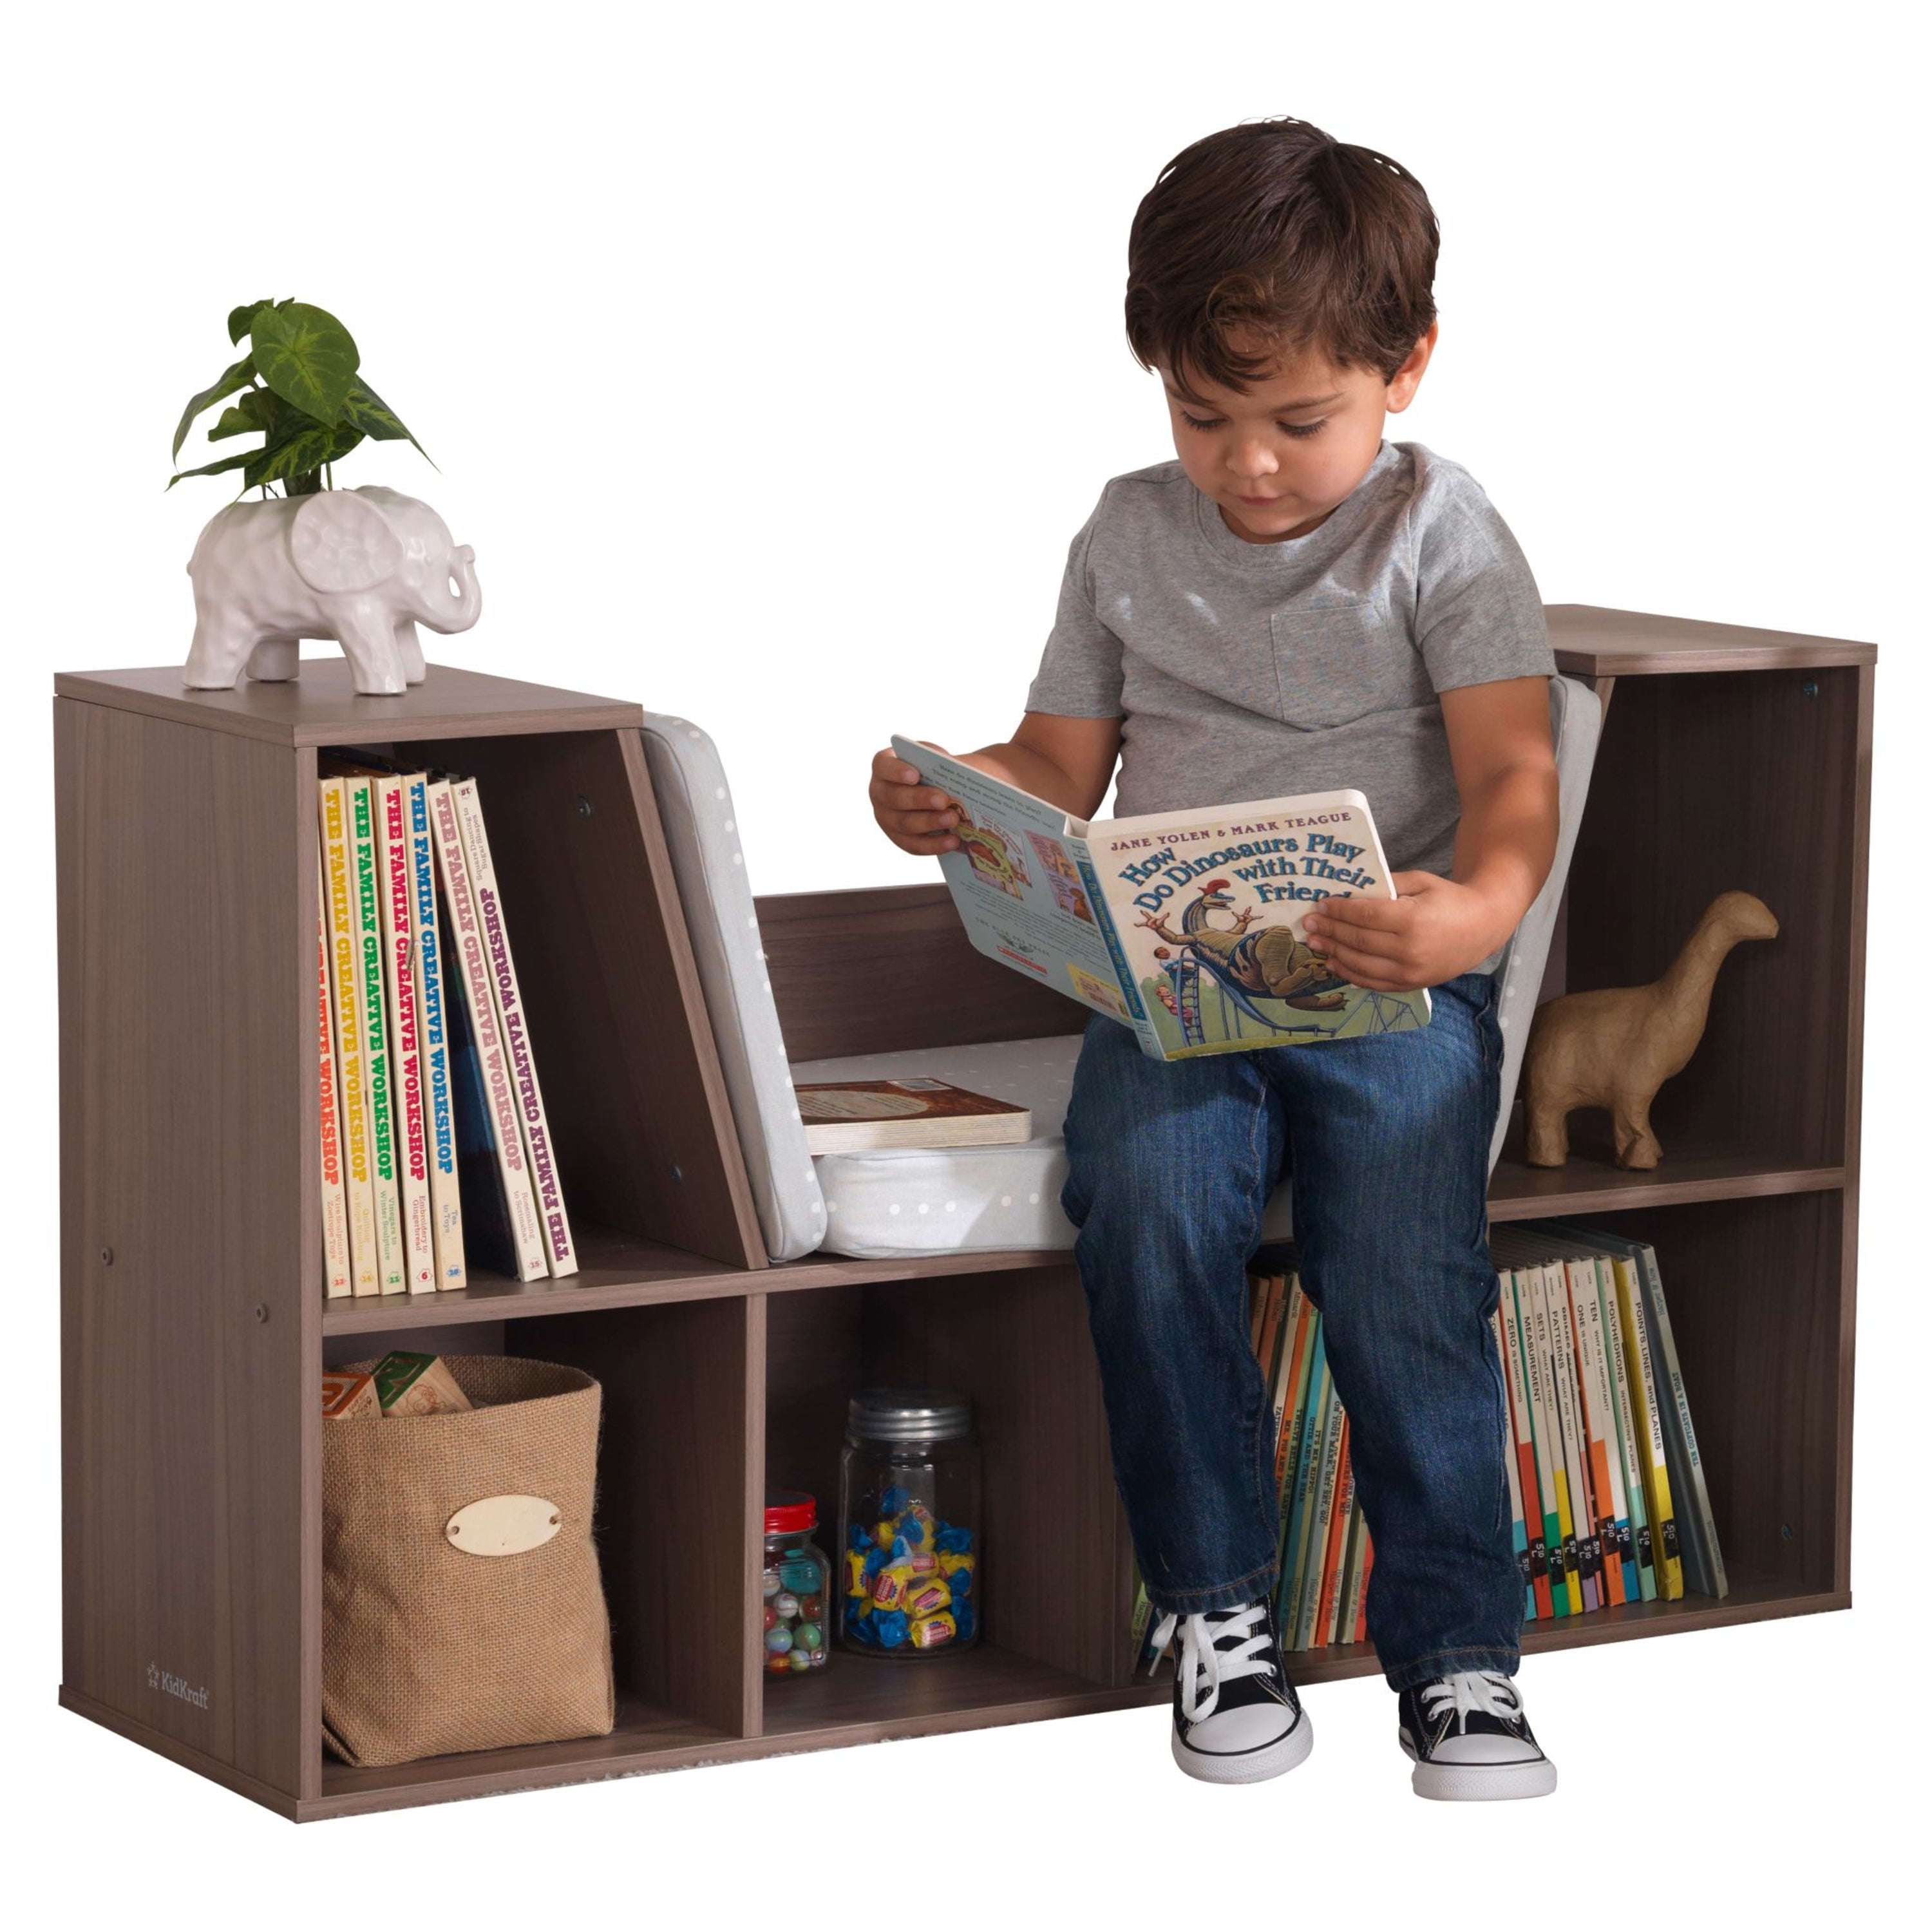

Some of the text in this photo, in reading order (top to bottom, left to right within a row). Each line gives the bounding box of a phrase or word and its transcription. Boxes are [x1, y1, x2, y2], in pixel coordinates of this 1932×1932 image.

[465, 816, 477, 851] Dancing
[472, 814, 488, 870] Sugar Shapes
[1110, 813, 1351, 851] JANE YOLEN & MARK TEAGUE
[471, 851, 482, 881] Square
[1119, 846, 1177, 886] How
[1133, 833, 1366, 913] Do Dinosaurs Play
[1232, 857, 1376, 889] with Their
[1253, 881, 1351, 903] Frien
[326, 789, 367, 1183] THE FAMILY CREATIVE WORKSHOP
[354, 788, 393, 1181] THE FAMILY CREATIVE WORKSHOP
[386, 790, 424, 1181] THE FAMILY CREATIVE WORKSHOP
[410, 782, 453, 1173] THE FAMILY CREATIVE WORKSHOP
[436, 793, 522, 1171] THE FAMILY CREATIVE WORKSHOP
[480, 888, 569, 1262] THE FAMILY CREATIVE WORKSHOP
[320, 1058, 339, 1185] WORKSHOP
[413, 1199, 422, 1251] Gingerbread
[418, 1195, 428, 1253] Embroidery to
[443, 1205, 449, 1213] to
[514, 1191, 529, 1244] to Scrimshaw
[522, 1193, 536, 1240] Rosemaling
[338, 1255, 344, 1265] to
[382, 1221, 390, 1260] Sculpture
[391, 1236, 396, 1245] to
[421, 1271, 428, 1280] 6
[1537, 1312, 1546, 1341] SETS
[1577, 1304, 1586, 1328] ONE
[1636, 1302, 1647, 1347] POINTS,
[1524, 1316, 1541, 1403] MEASUREMENT
[1552, 1311, 1565, 1369] PATTERNS
[1589, 1299, 1598, 1322] TEN
[1599, 1365, 1609, 1411] IMPORTANT?
[1508, 1318, 1517, 1347] ZERO
[1513, 1359, 1522, 1403] SOMETHING
[1608, 1300, 1624, 1383] POLYHEDRONS
[1620, 1390, 1631, 1441] INTERSECTING
[1647, 1385, 1656, 1404] and
[1671, 1372, 1682, 1392] BOAT
[1334, 1400, 1340, 1412] ON
[1678, 1401, 1686, 1410] IN
[1651, 1406, 1662, 1450] PLANES
[1681, 1412, 1695, 1449] COPYCATS
[1689, 1451, 1699, 1466] TEN
[1536, 1544, 1544, 1558] 510
[1622, 1527, 1630, 1540] 510
[162, 1671, 208, 1710] KidKraft
